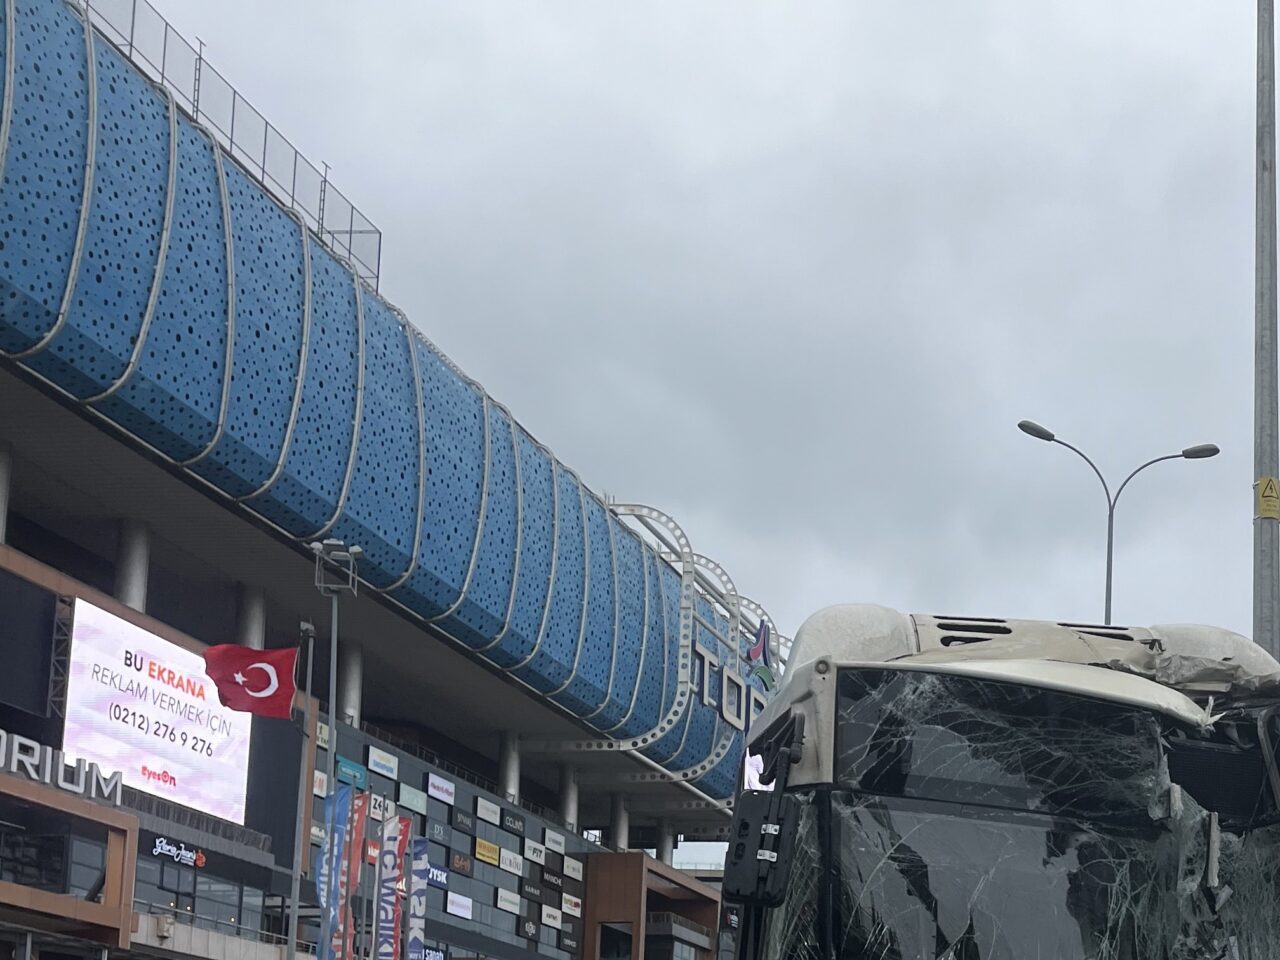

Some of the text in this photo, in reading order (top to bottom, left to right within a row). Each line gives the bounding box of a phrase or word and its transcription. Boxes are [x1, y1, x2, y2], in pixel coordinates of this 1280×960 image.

[91, 663, 232, 737] REKLAM VERMEK İÇİN
[124, 650, 206, 701] BU EKRANA
[109, 702, 213, 757] (0212) 276 9 276
[428, 868, 448, 885] JYSK
